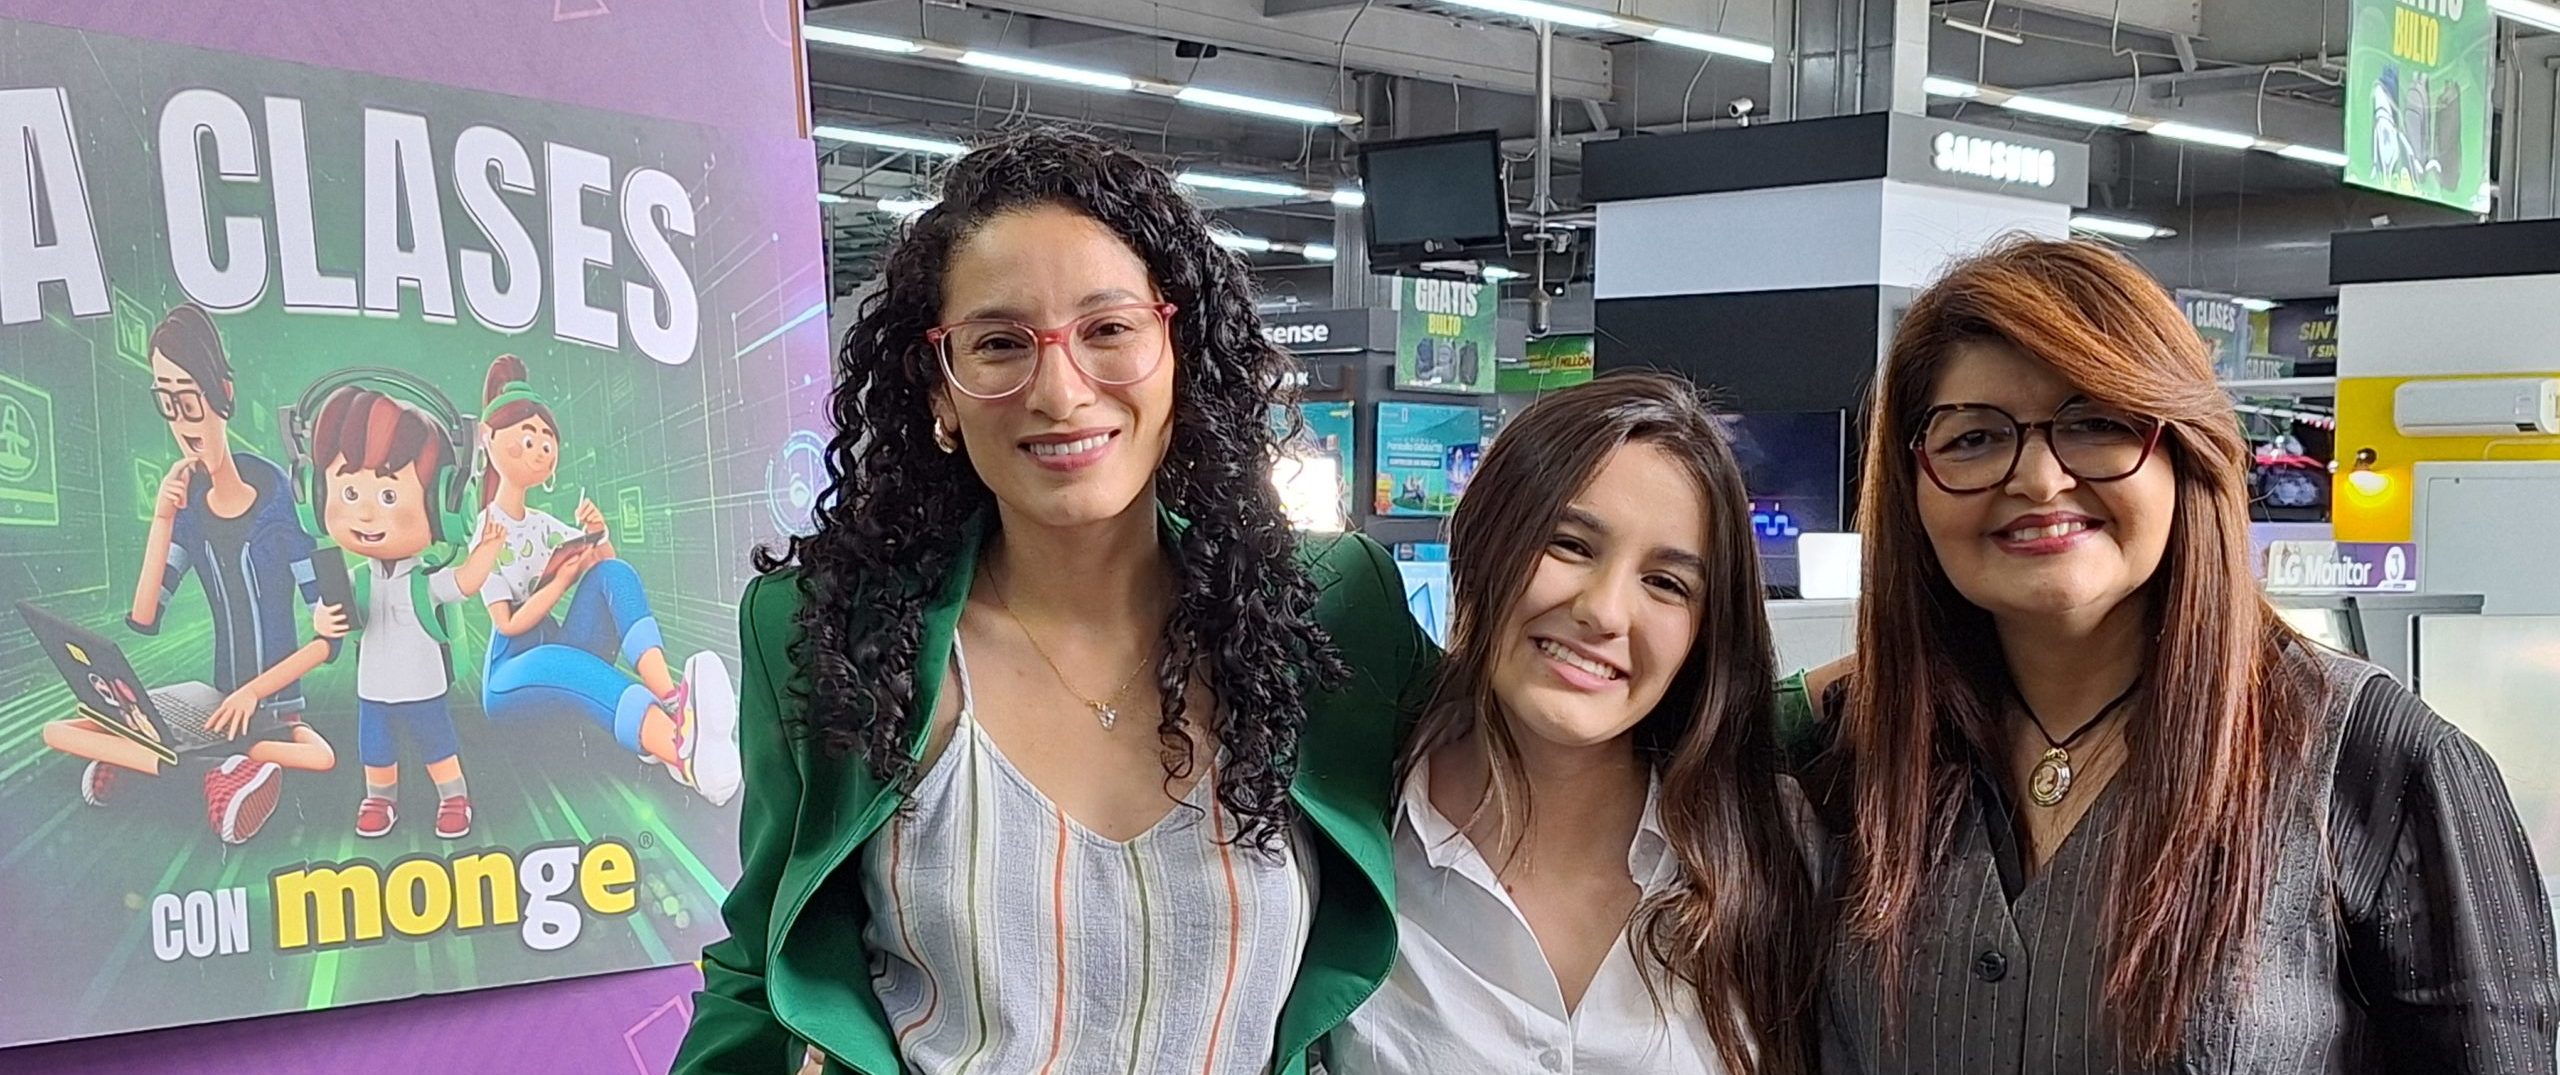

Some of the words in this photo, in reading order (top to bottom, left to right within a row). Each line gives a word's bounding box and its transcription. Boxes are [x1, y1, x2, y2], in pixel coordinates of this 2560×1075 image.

[2394, 6, 2439, 67] BULTO
[1932, 131, 2056, 188] SAMSUNG
[0, 87, 112, 326] A
[158, 88, 700, 366] CLASES
[1428, 313, 1462, 337] BULTO
[2195, 302, 2236, 333] CLASES
[2298, 321, 2332, 341] SIN
[2307, 345, 2315, 358] Y
[2274, 554, 2300, 585] LG
[2304, 555, 2372, 586] Monitor
[152, 887, 251, 961] CON
[275, 842, 637, 951] monge
